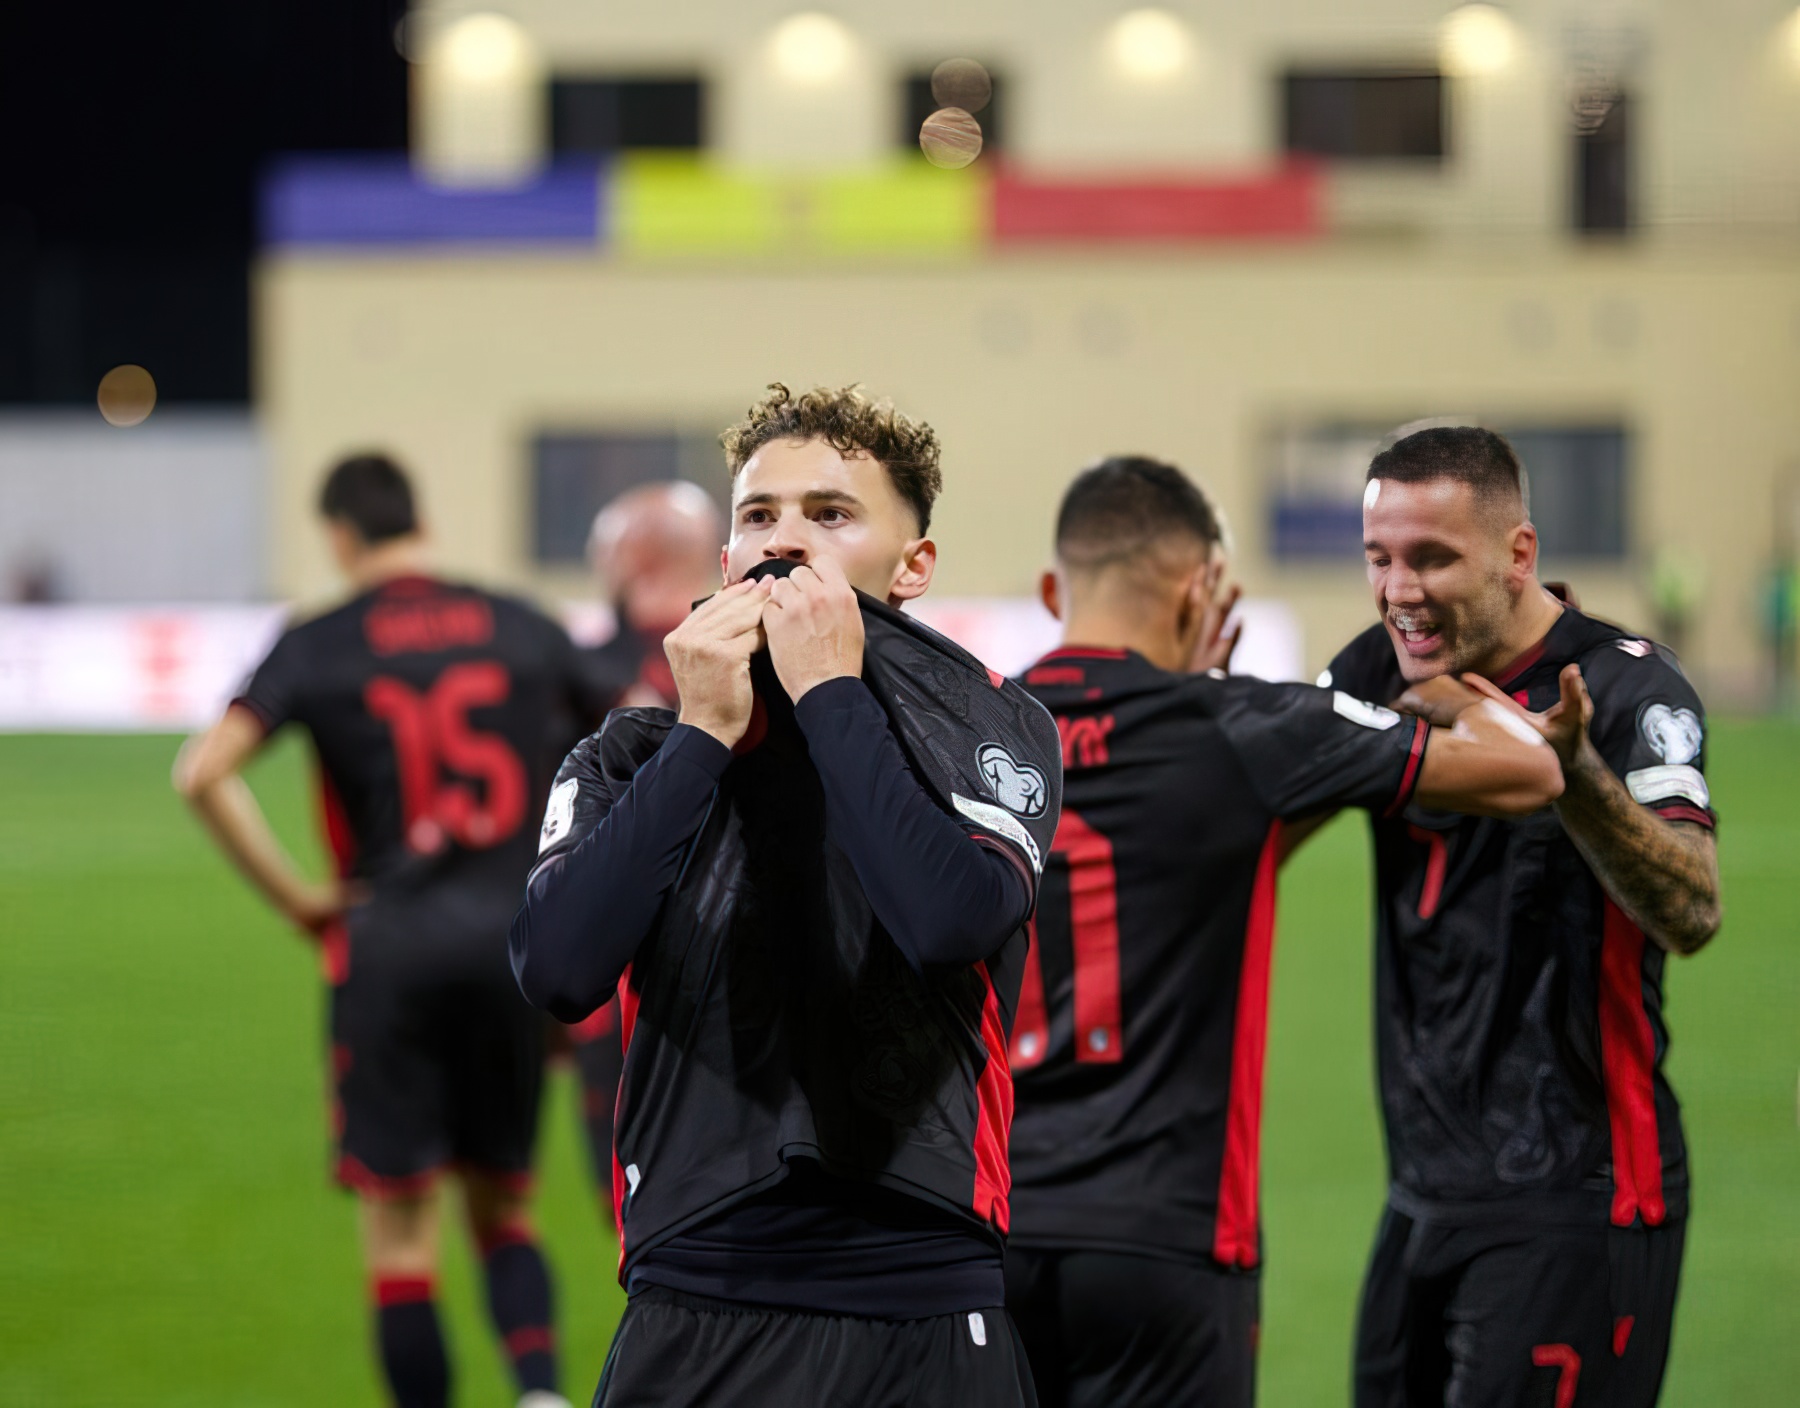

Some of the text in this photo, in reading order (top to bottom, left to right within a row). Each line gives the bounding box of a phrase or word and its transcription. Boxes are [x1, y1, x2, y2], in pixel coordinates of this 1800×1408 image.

[365, 662, 528, 852] 15
[1408, 823, 1448, 919] 7
[1532, 1343, 1581, 1408] 7
